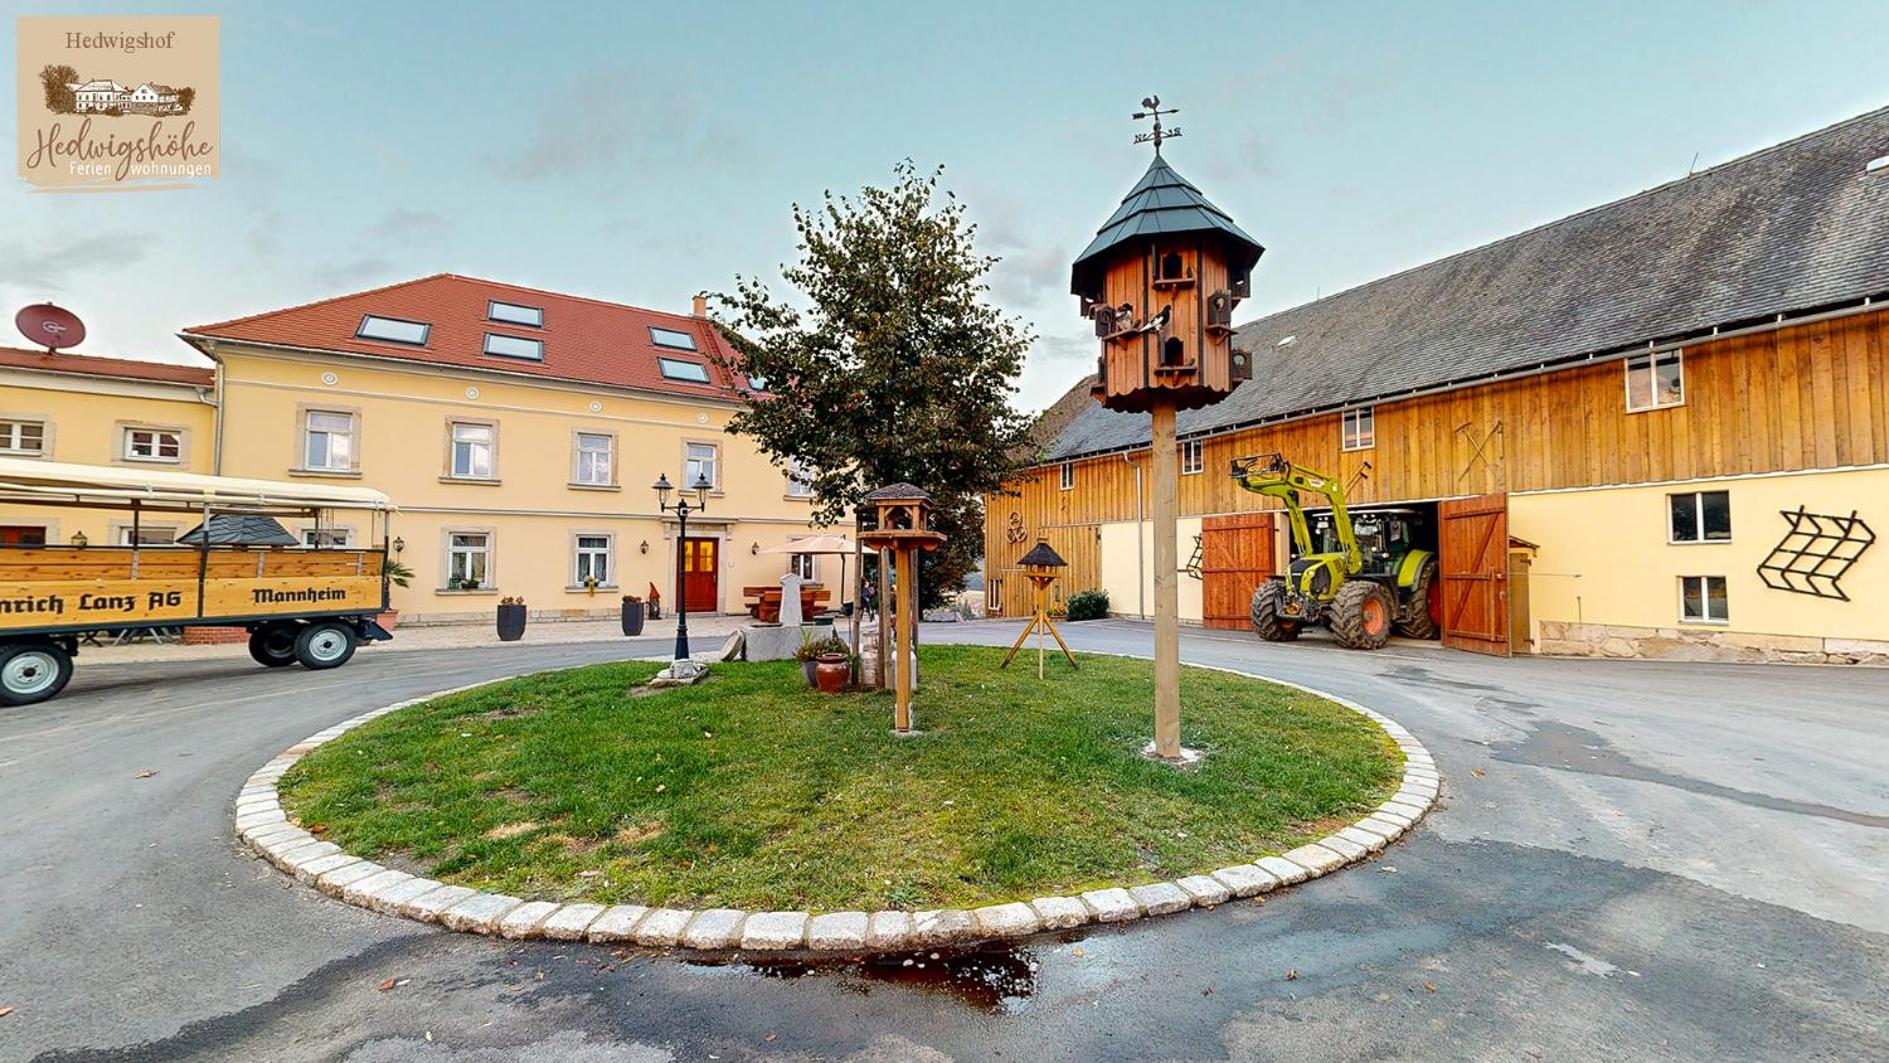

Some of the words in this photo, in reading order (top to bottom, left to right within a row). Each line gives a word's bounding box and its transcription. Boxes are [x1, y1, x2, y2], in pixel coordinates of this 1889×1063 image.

[78, 593, 135, 612] Lanz
[148, 591, 182, 610] AG
[252, 587, 346, 603] Mannheim
